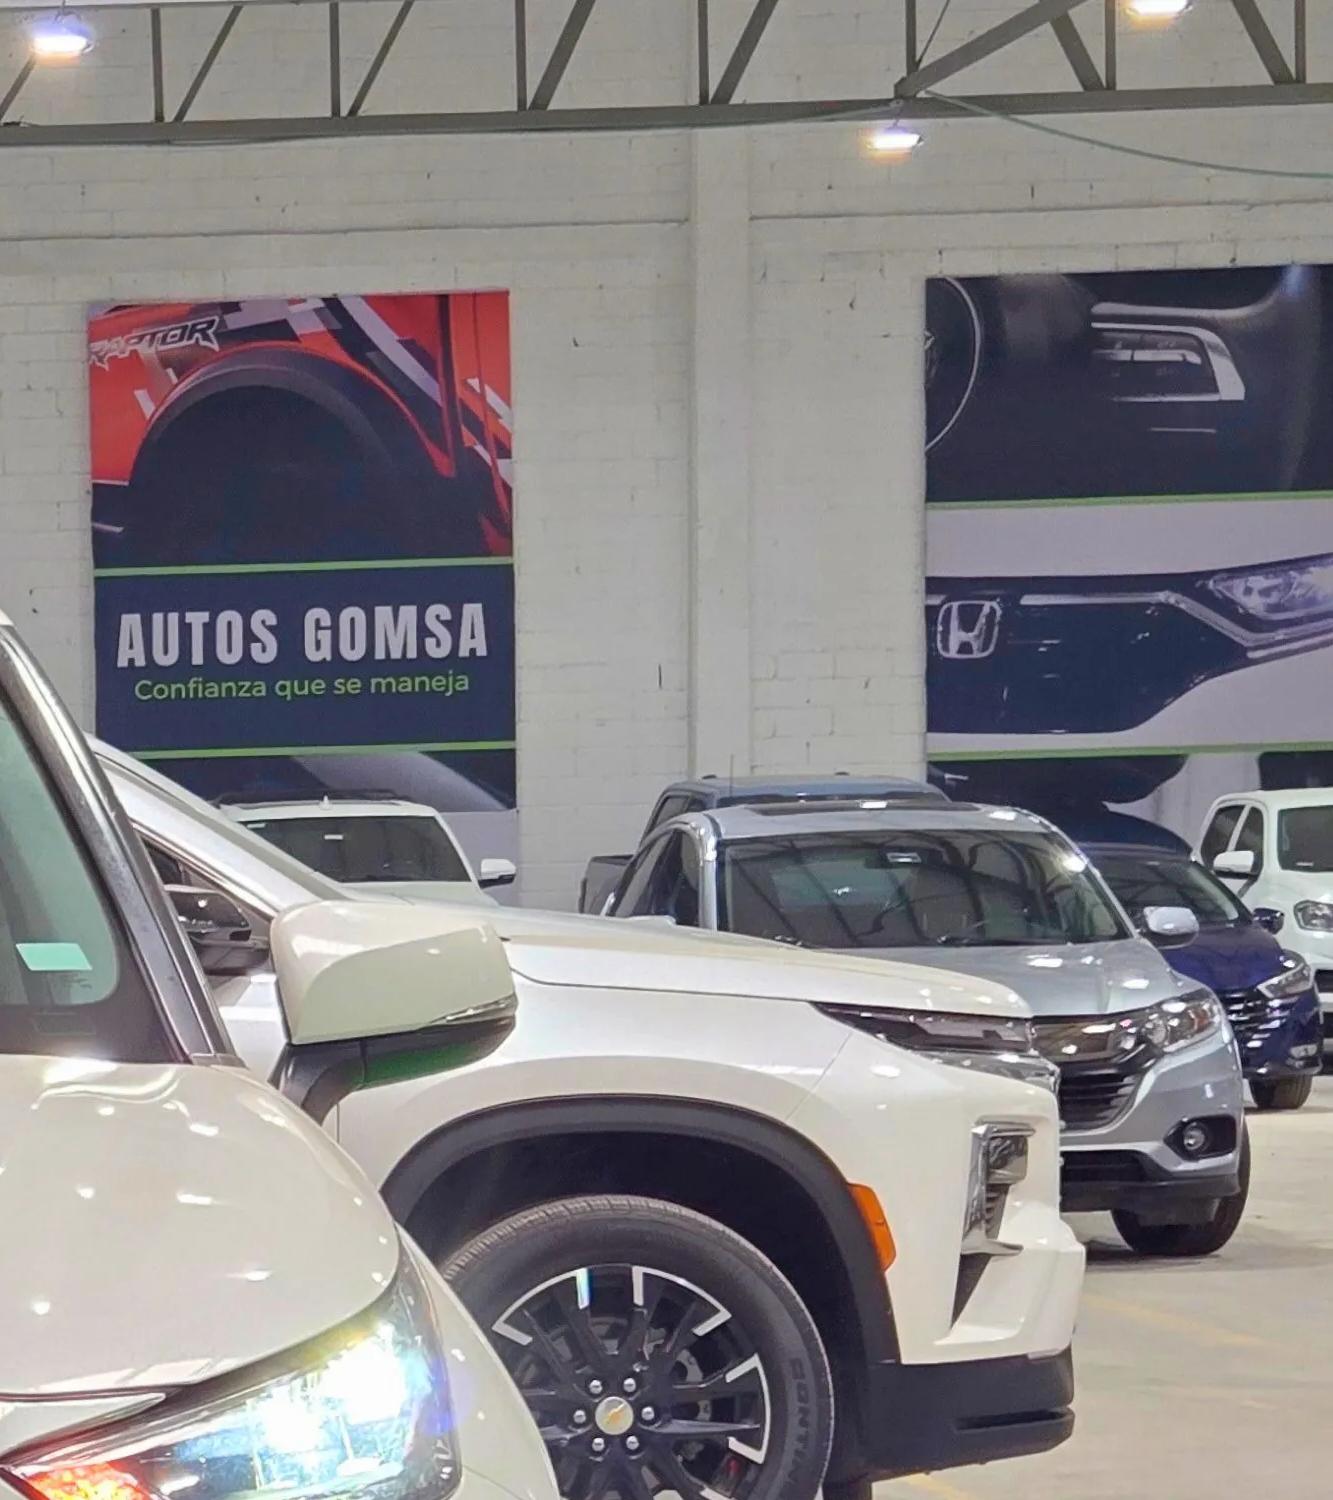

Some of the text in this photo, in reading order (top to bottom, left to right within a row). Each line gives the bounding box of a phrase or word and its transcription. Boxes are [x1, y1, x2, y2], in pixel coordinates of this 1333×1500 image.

[117, 603, 489, 669] AUTOS GOMSA
[135, 669, 469, 702] Confianza que se maneja
